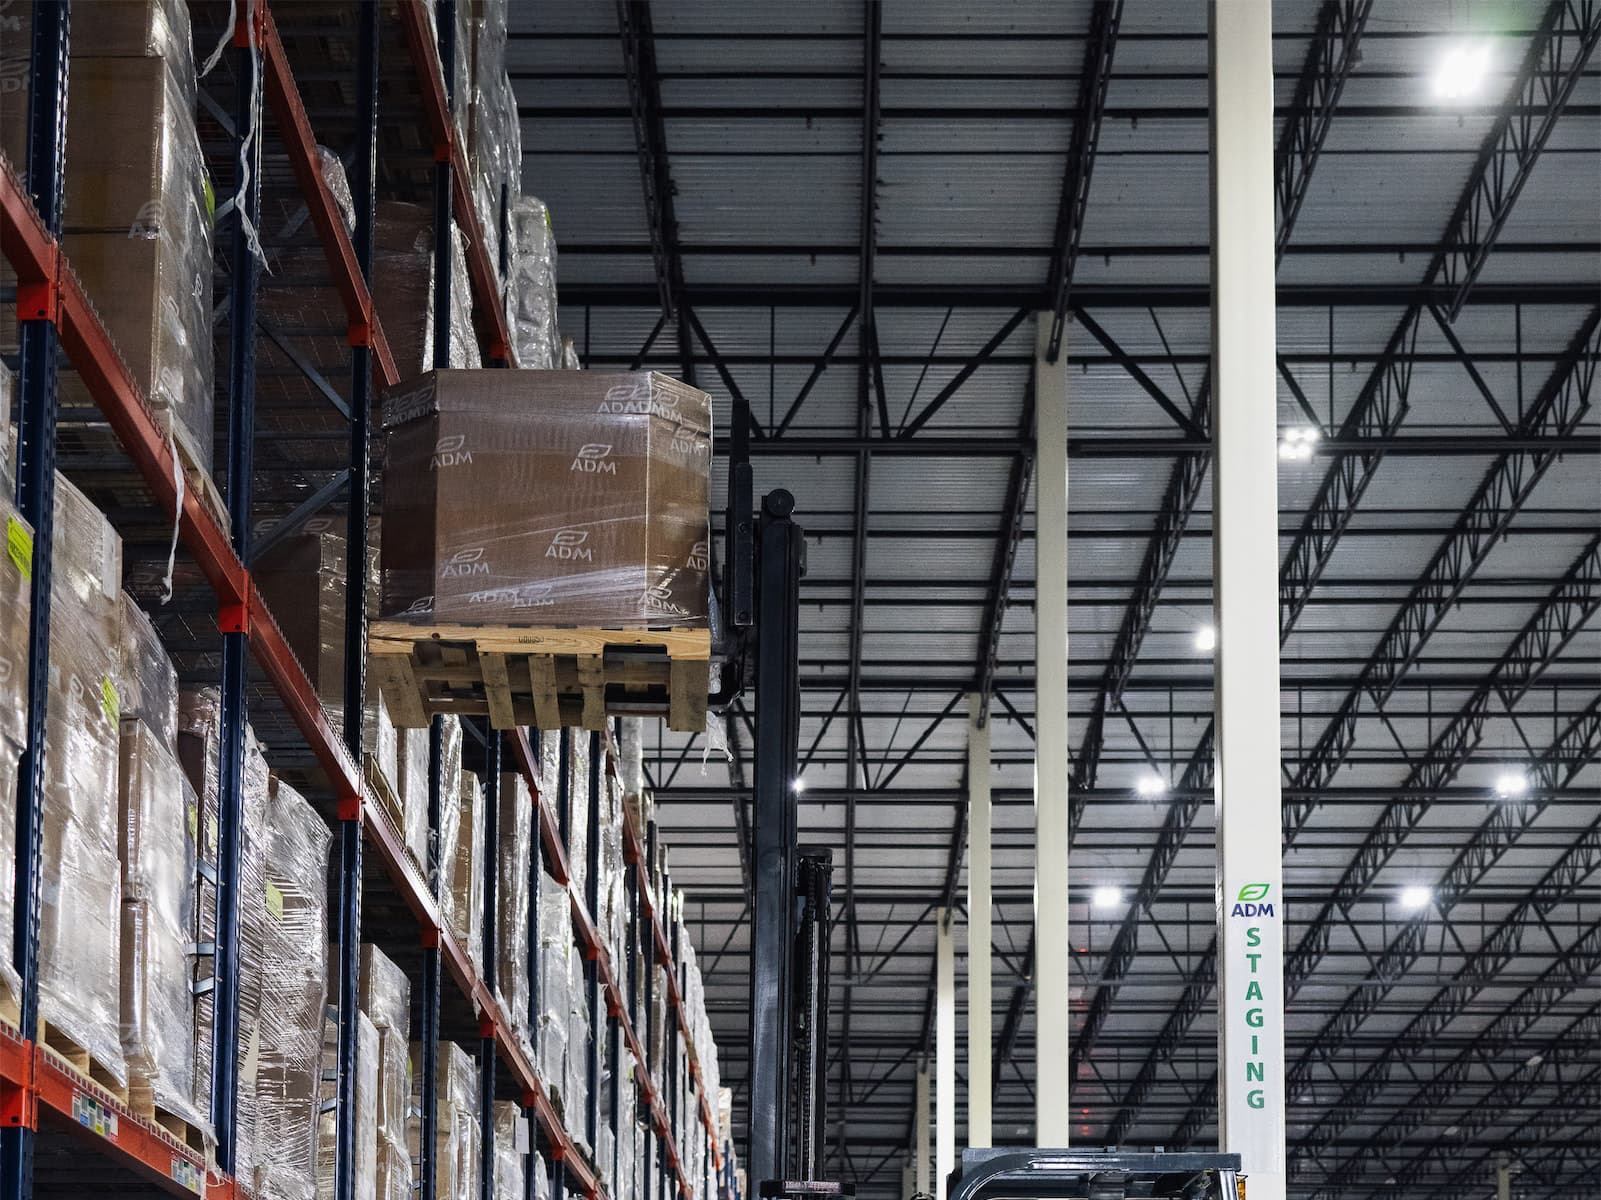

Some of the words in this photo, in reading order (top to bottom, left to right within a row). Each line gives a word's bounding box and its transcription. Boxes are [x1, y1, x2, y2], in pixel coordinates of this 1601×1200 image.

[429, 451, 473, 471] ADM
[571, 458, 616, 475] ADM
[545, 546, 592, 561] ADM
[442, 562, 490, 577] ADM
[686, 556, 707, 571] AD
[1231, 903, 1274, 918] ADM
[1246, 927, 1265, 1110] STAGING
